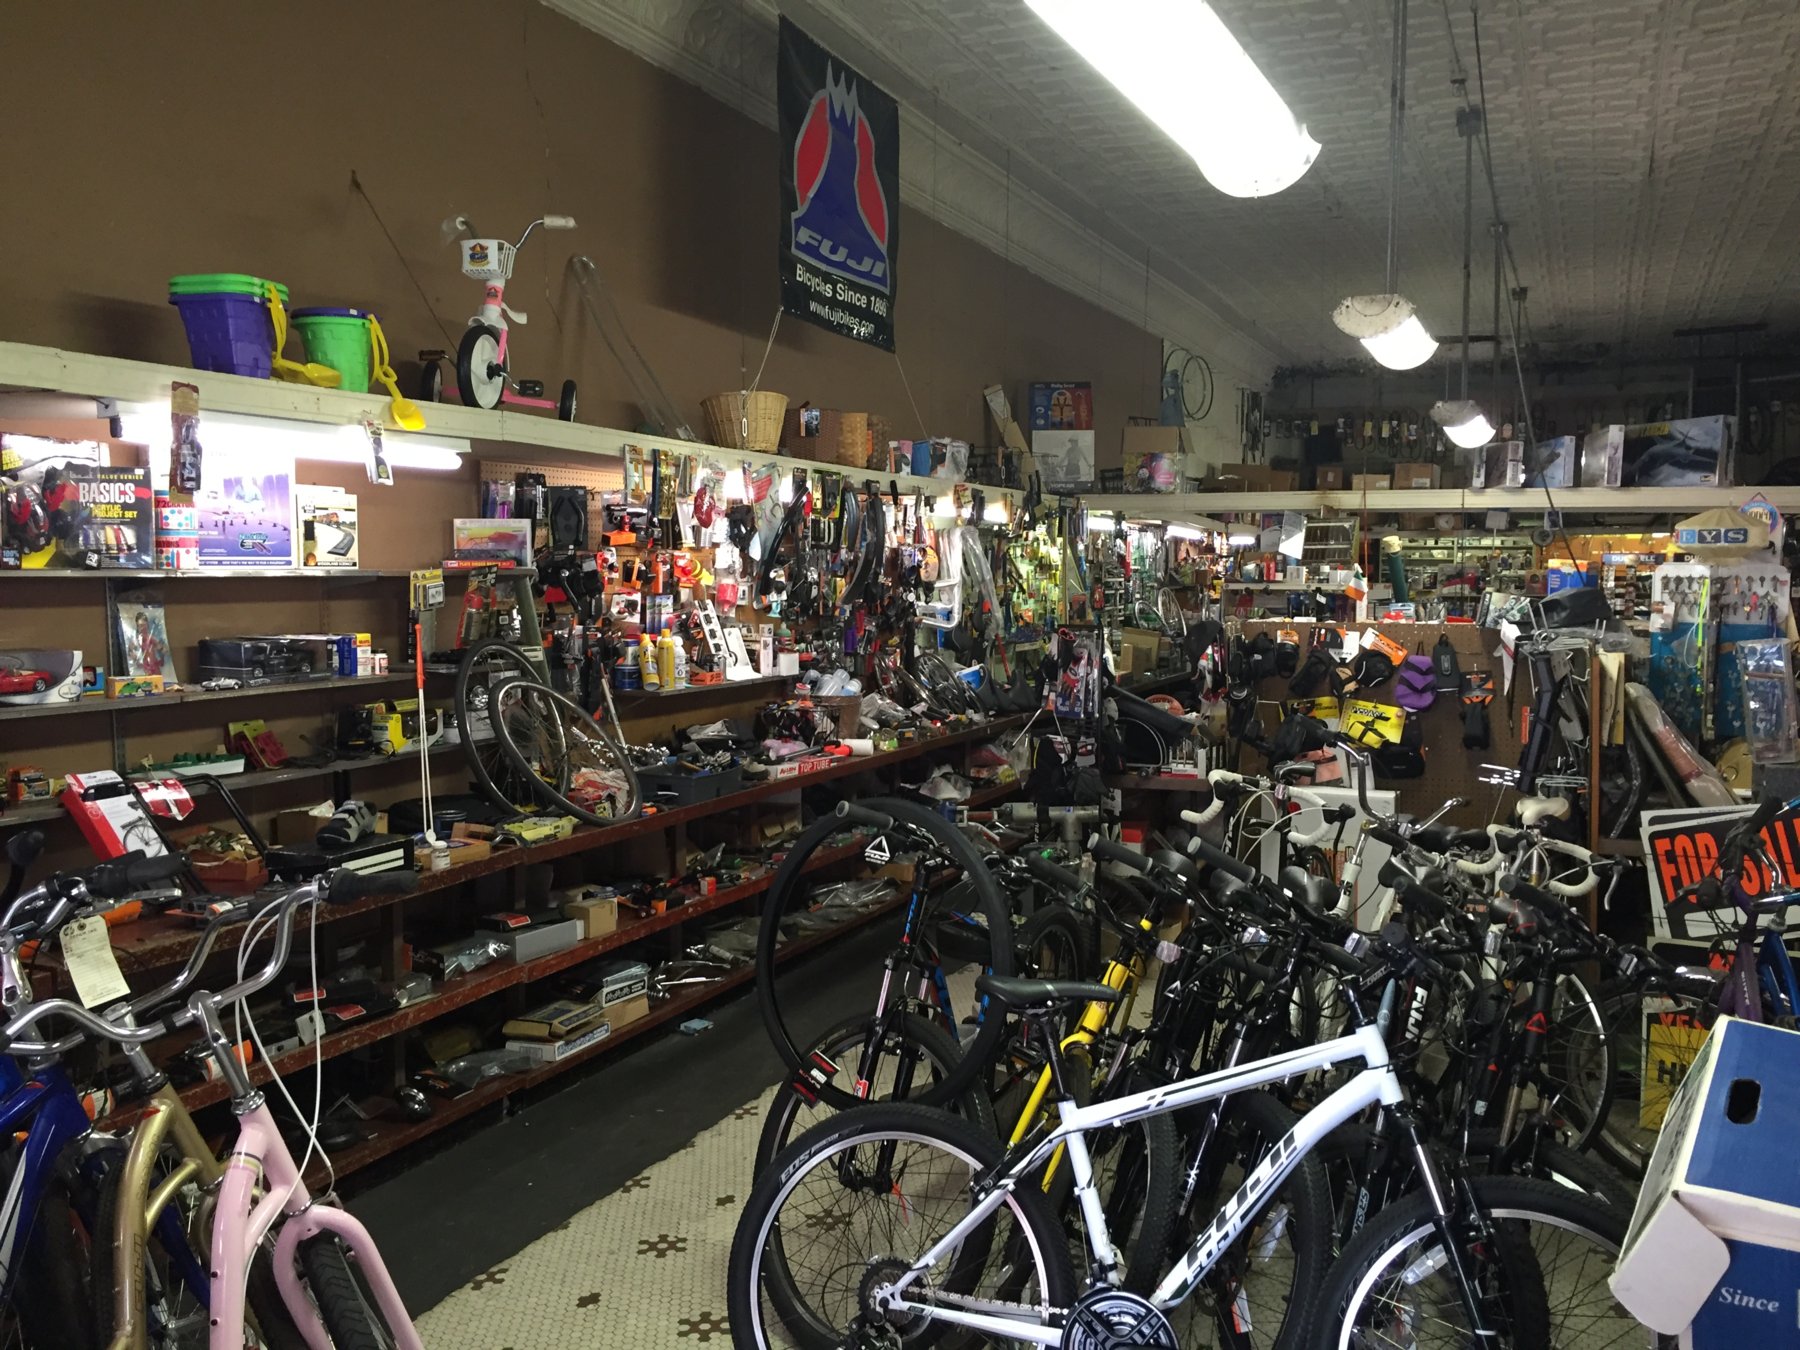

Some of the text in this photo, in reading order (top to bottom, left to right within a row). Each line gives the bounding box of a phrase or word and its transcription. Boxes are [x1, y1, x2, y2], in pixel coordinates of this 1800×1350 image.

[796, 226, 886, 277] FUJI
[796, 264, 833, 298] Bicycles
[836, 283, 868, 309] Since
[79, 482, 136, 503] BASICS
[1674, 528, 1747, 545] EYS
[1611, 554, 1656, 562] DUELL
[800, 763, 813, 772] TOP
[813, 759, 830, 771] TUBE
[1740, 817, 1800, 896] SAL
[1405, 985, 1428, 1042] FUJI
[1186, 1130, 1298, 1270] FUJI
[1719, 1286, 1779, 1312] Since
